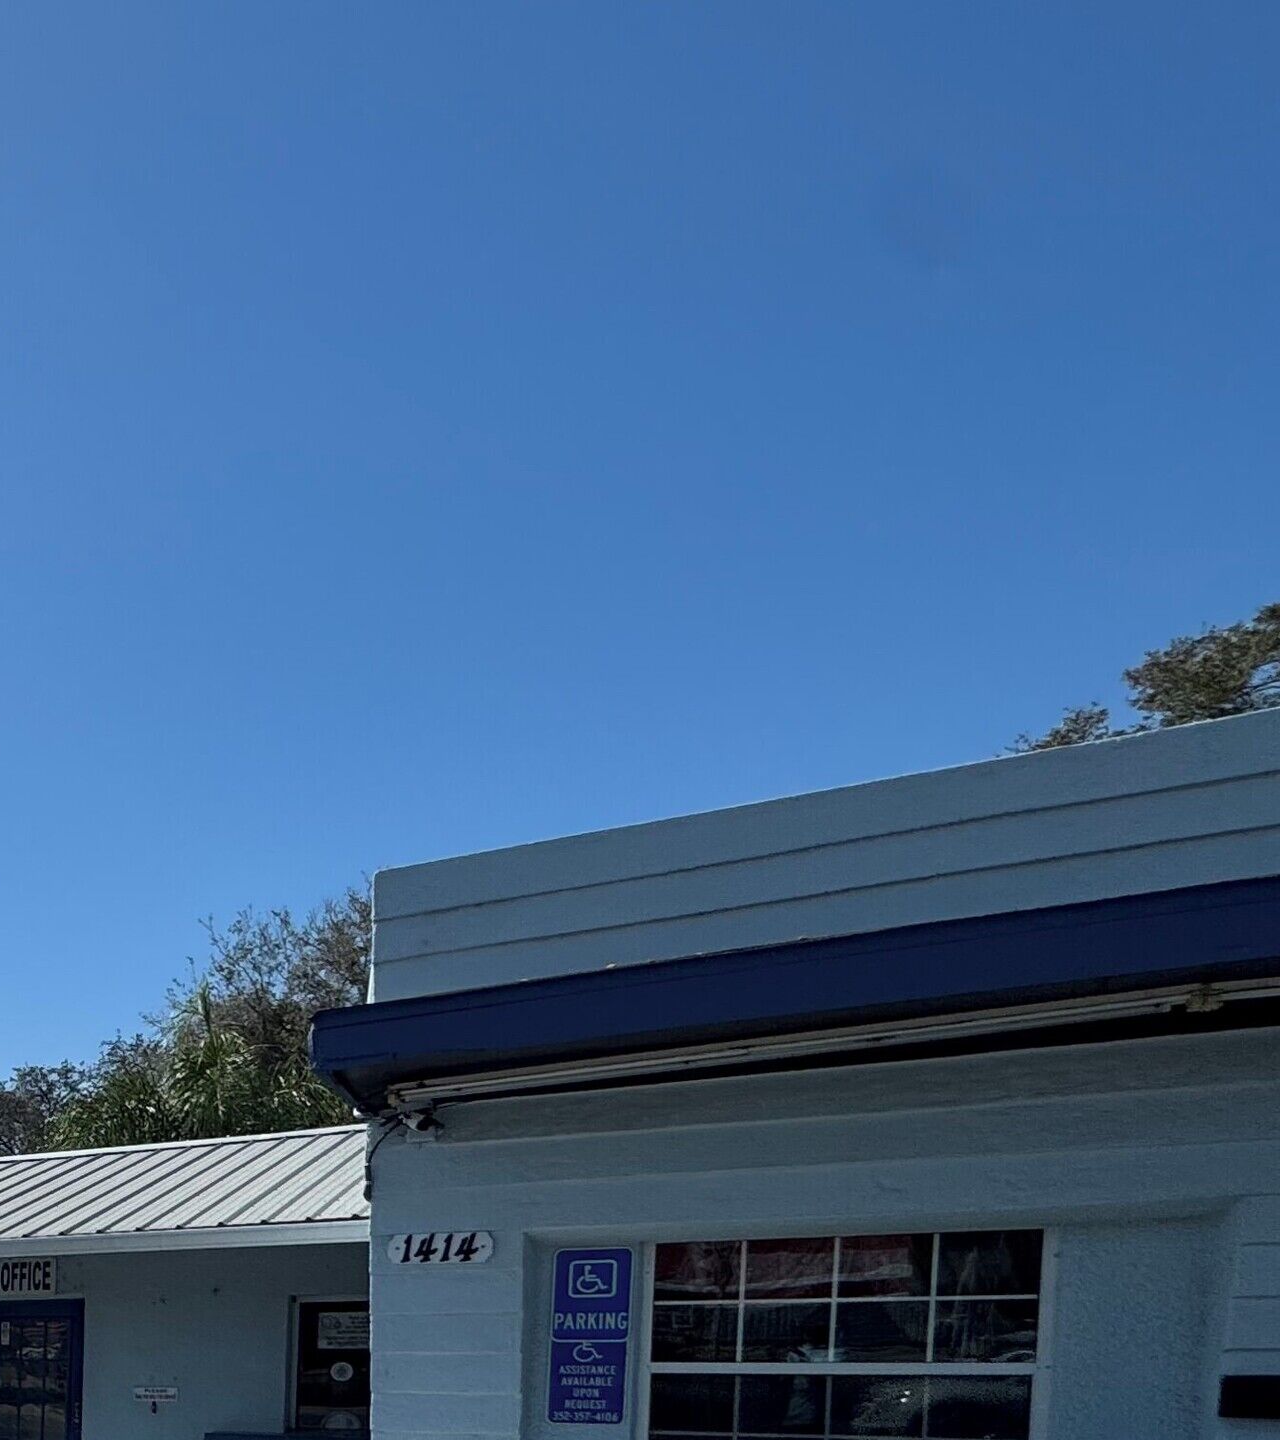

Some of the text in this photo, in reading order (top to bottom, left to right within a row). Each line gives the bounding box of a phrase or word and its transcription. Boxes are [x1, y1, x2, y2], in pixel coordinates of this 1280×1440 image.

[401, 1232, 479, 1263] 1414
[0, 1261, 51, 1292] OFFICE
[554, 1312, 628, 1330] PARKING
[560, 1365, 617, 1375] ASSISTANCE
[561, 1376, 614, 1387] AVAILABLE
[572, 1387, 600, 1398] UPON
[564, 1398, 607, 1409] REQUEST
